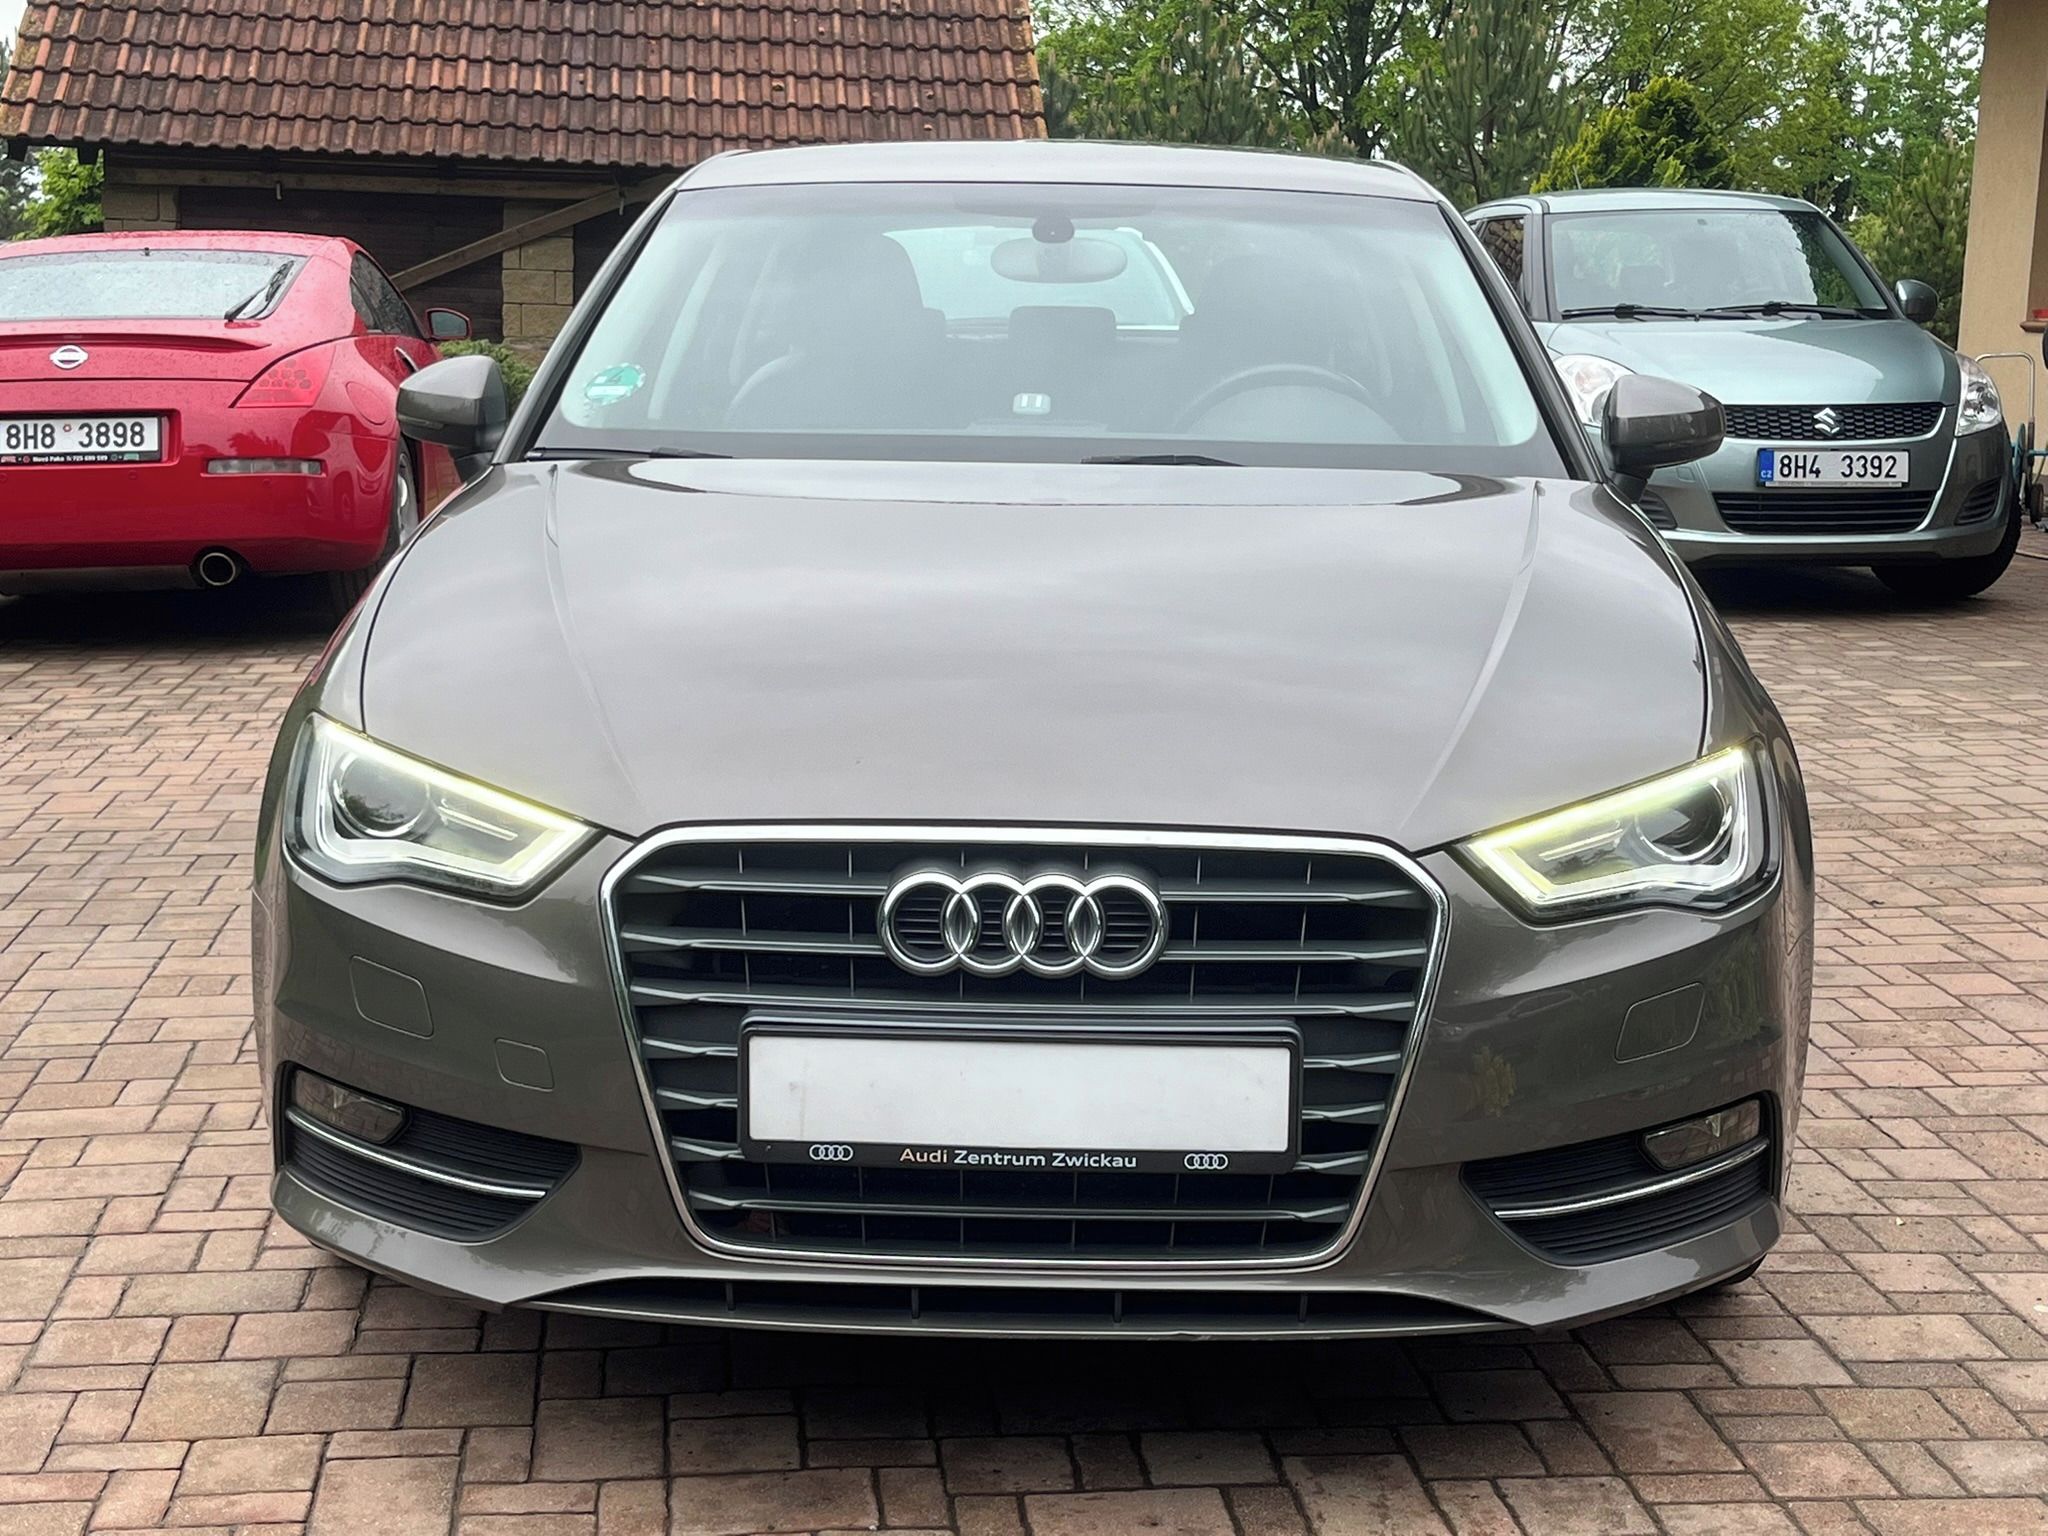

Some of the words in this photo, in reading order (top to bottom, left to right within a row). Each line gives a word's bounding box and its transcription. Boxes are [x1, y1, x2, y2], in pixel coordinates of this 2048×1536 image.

[6, 423, 55, 450] 8H8
[78, 421, 145, 448] 3898
[1760, 470, 1772, 479] CZ
[1779, 454, 1821, 479] 8H4
[1840, 454, 1897, 479] 3392
[900, 1148, 948, 1164] Audi
[953, 1150, 1046, 1168] Zentrum
[1051, 1152, 1137, 1169] Zwickau
